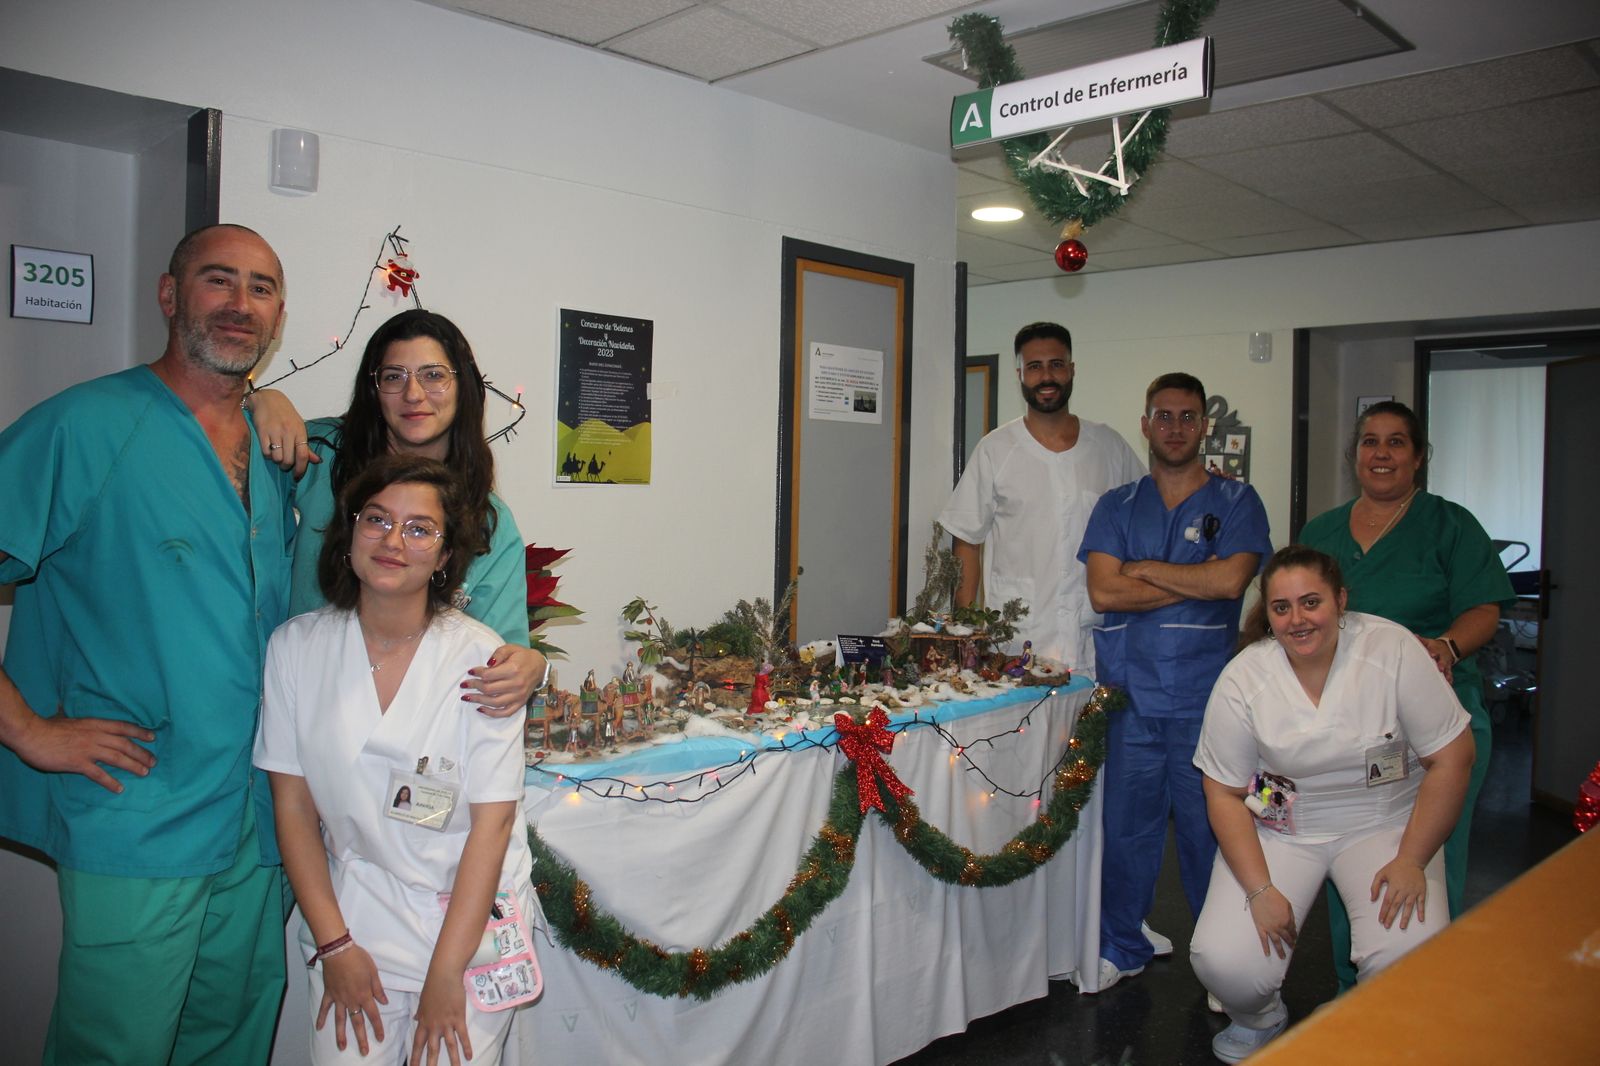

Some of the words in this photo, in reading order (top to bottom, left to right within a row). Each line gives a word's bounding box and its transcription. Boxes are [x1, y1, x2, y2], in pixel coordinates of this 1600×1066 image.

[999, 91, 1059, 118] Control
[1063, 87, 1083, 105] de
[1088, 61, 1187, 99] Enfermería
[23, 262, 85, 287] 3205
[25, 296, 82, 310] Habitación
[605, 322, 612, 331] de
[612, 323, 634, 334] Belenes
[578, 336, 608, 348] Decoración
[597, 347, 614, 358] 2023
